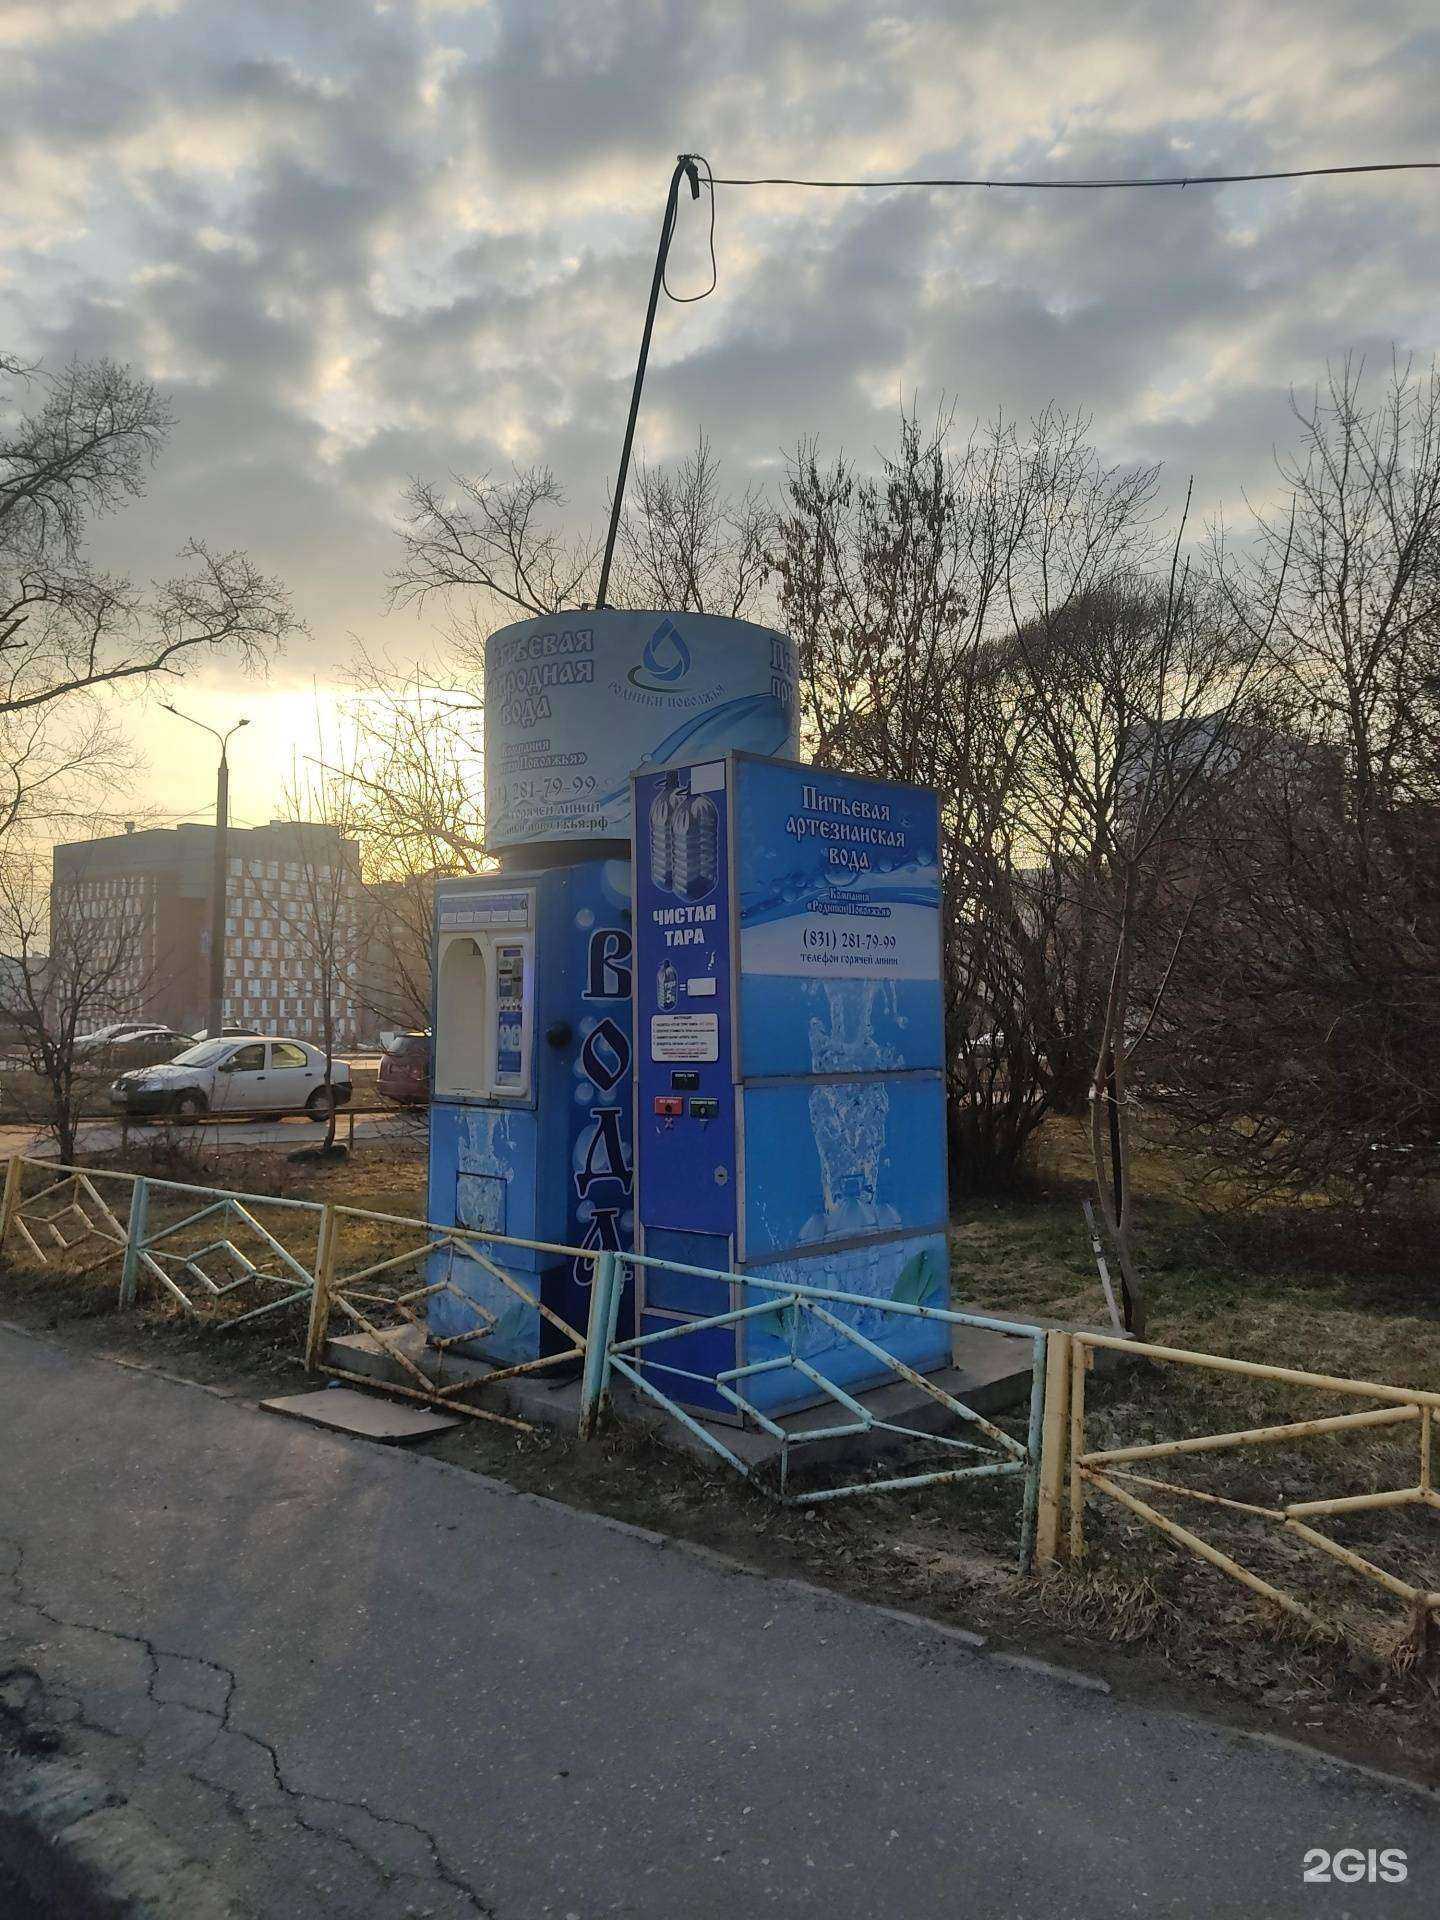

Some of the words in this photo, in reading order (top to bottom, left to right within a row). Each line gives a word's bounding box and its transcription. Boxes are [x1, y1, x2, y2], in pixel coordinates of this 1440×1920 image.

[802, 785, 890, 821] Питьевая
[787, 816, 905, 847] артезианская
[829, 848, 869, 871] вода
[652, 904, 716, 925] ЧИСТАЯ
[664, 928, 705, 947] ТАРА
[803, 928, 836, 950] (831)
[841, 933, 896, 950] 281-79-99
[800, 950, 839, 967] телефон
